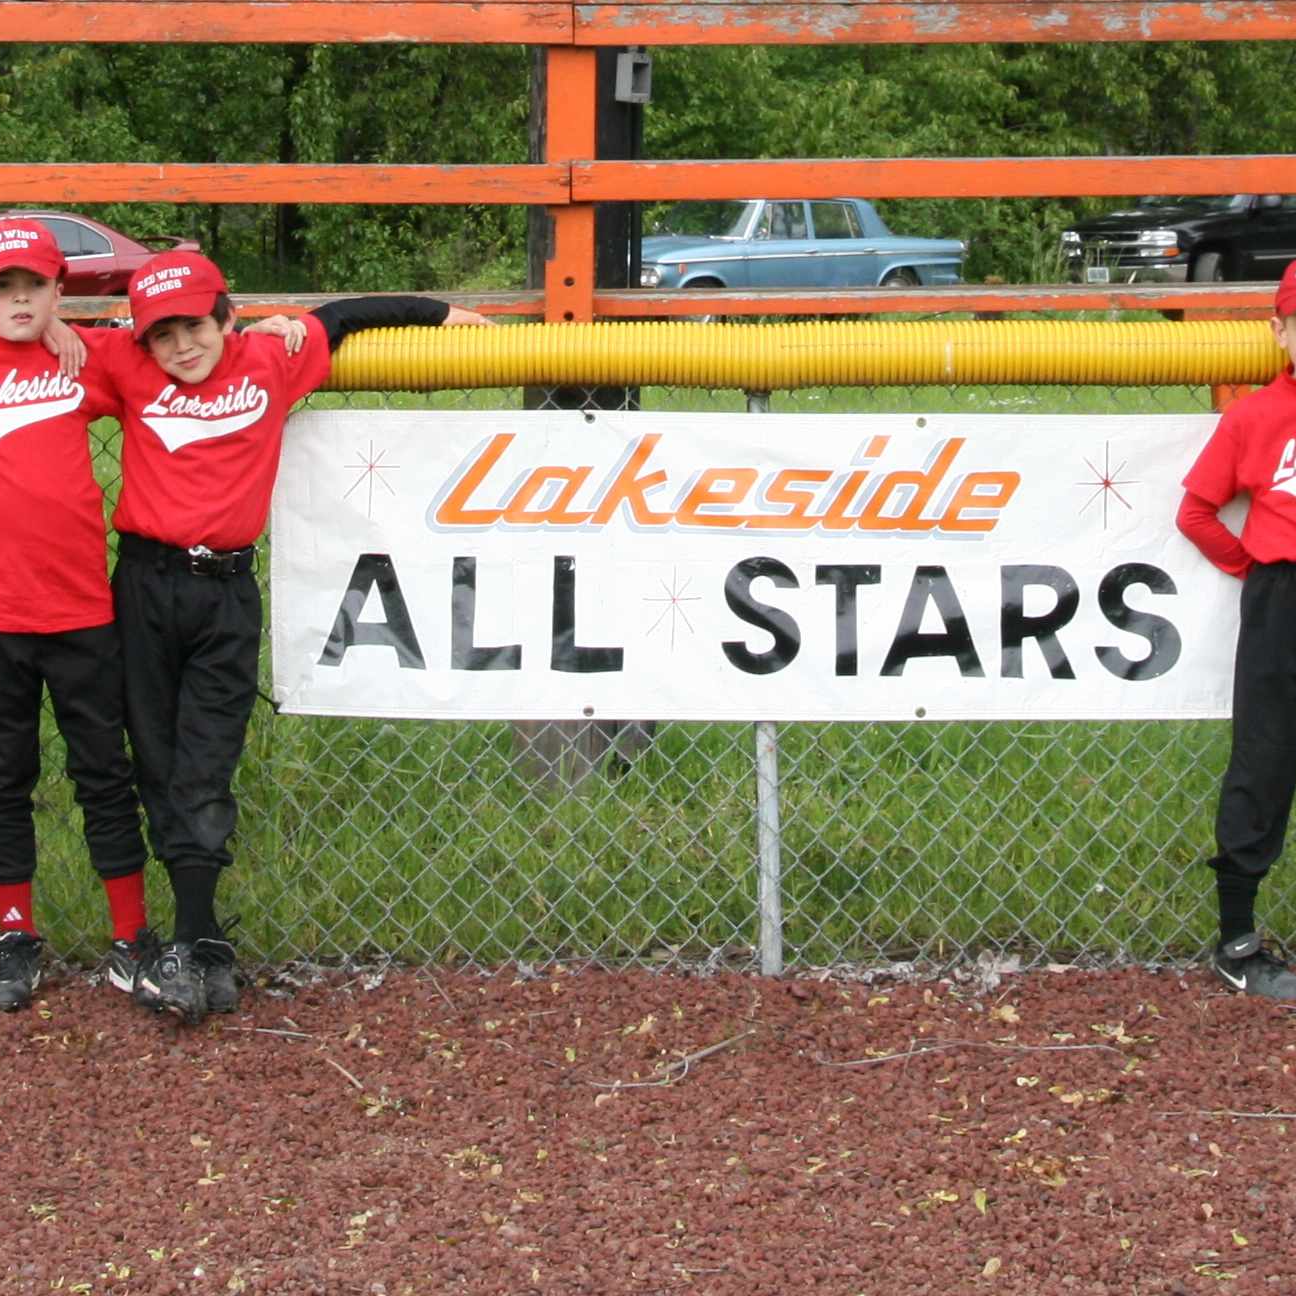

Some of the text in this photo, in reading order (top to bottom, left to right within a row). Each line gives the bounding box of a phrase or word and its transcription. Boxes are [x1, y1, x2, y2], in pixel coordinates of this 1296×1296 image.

[136, 274, 156, 291] RED
[145, 279, 182, 297] SHOES
[143, 376, 262, 417] Lakeside
[427, 432, 1022, 538] Lakeside
[315, 553, 1182, 682] ALL STARS
